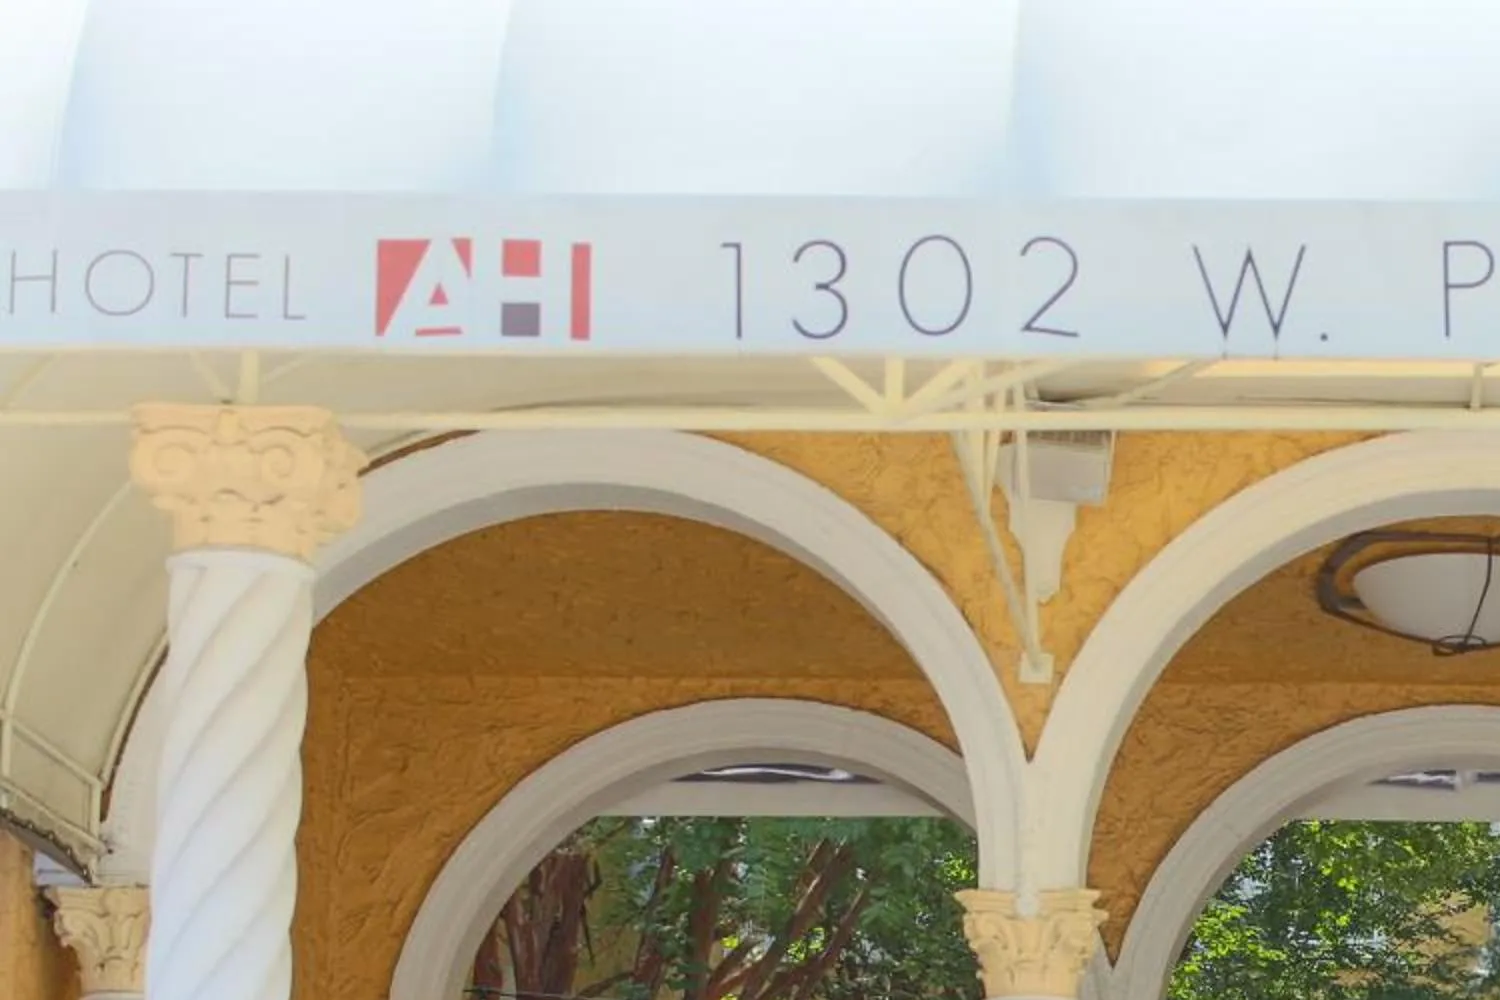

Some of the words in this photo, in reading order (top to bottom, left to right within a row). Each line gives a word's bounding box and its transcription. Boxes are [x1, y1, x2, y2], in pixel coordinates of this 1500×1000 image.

[9, 249, 306, 319] HOTEL
[720, 234, 1079, 340] 1302
[1192, 243, 1329, 341] W.
